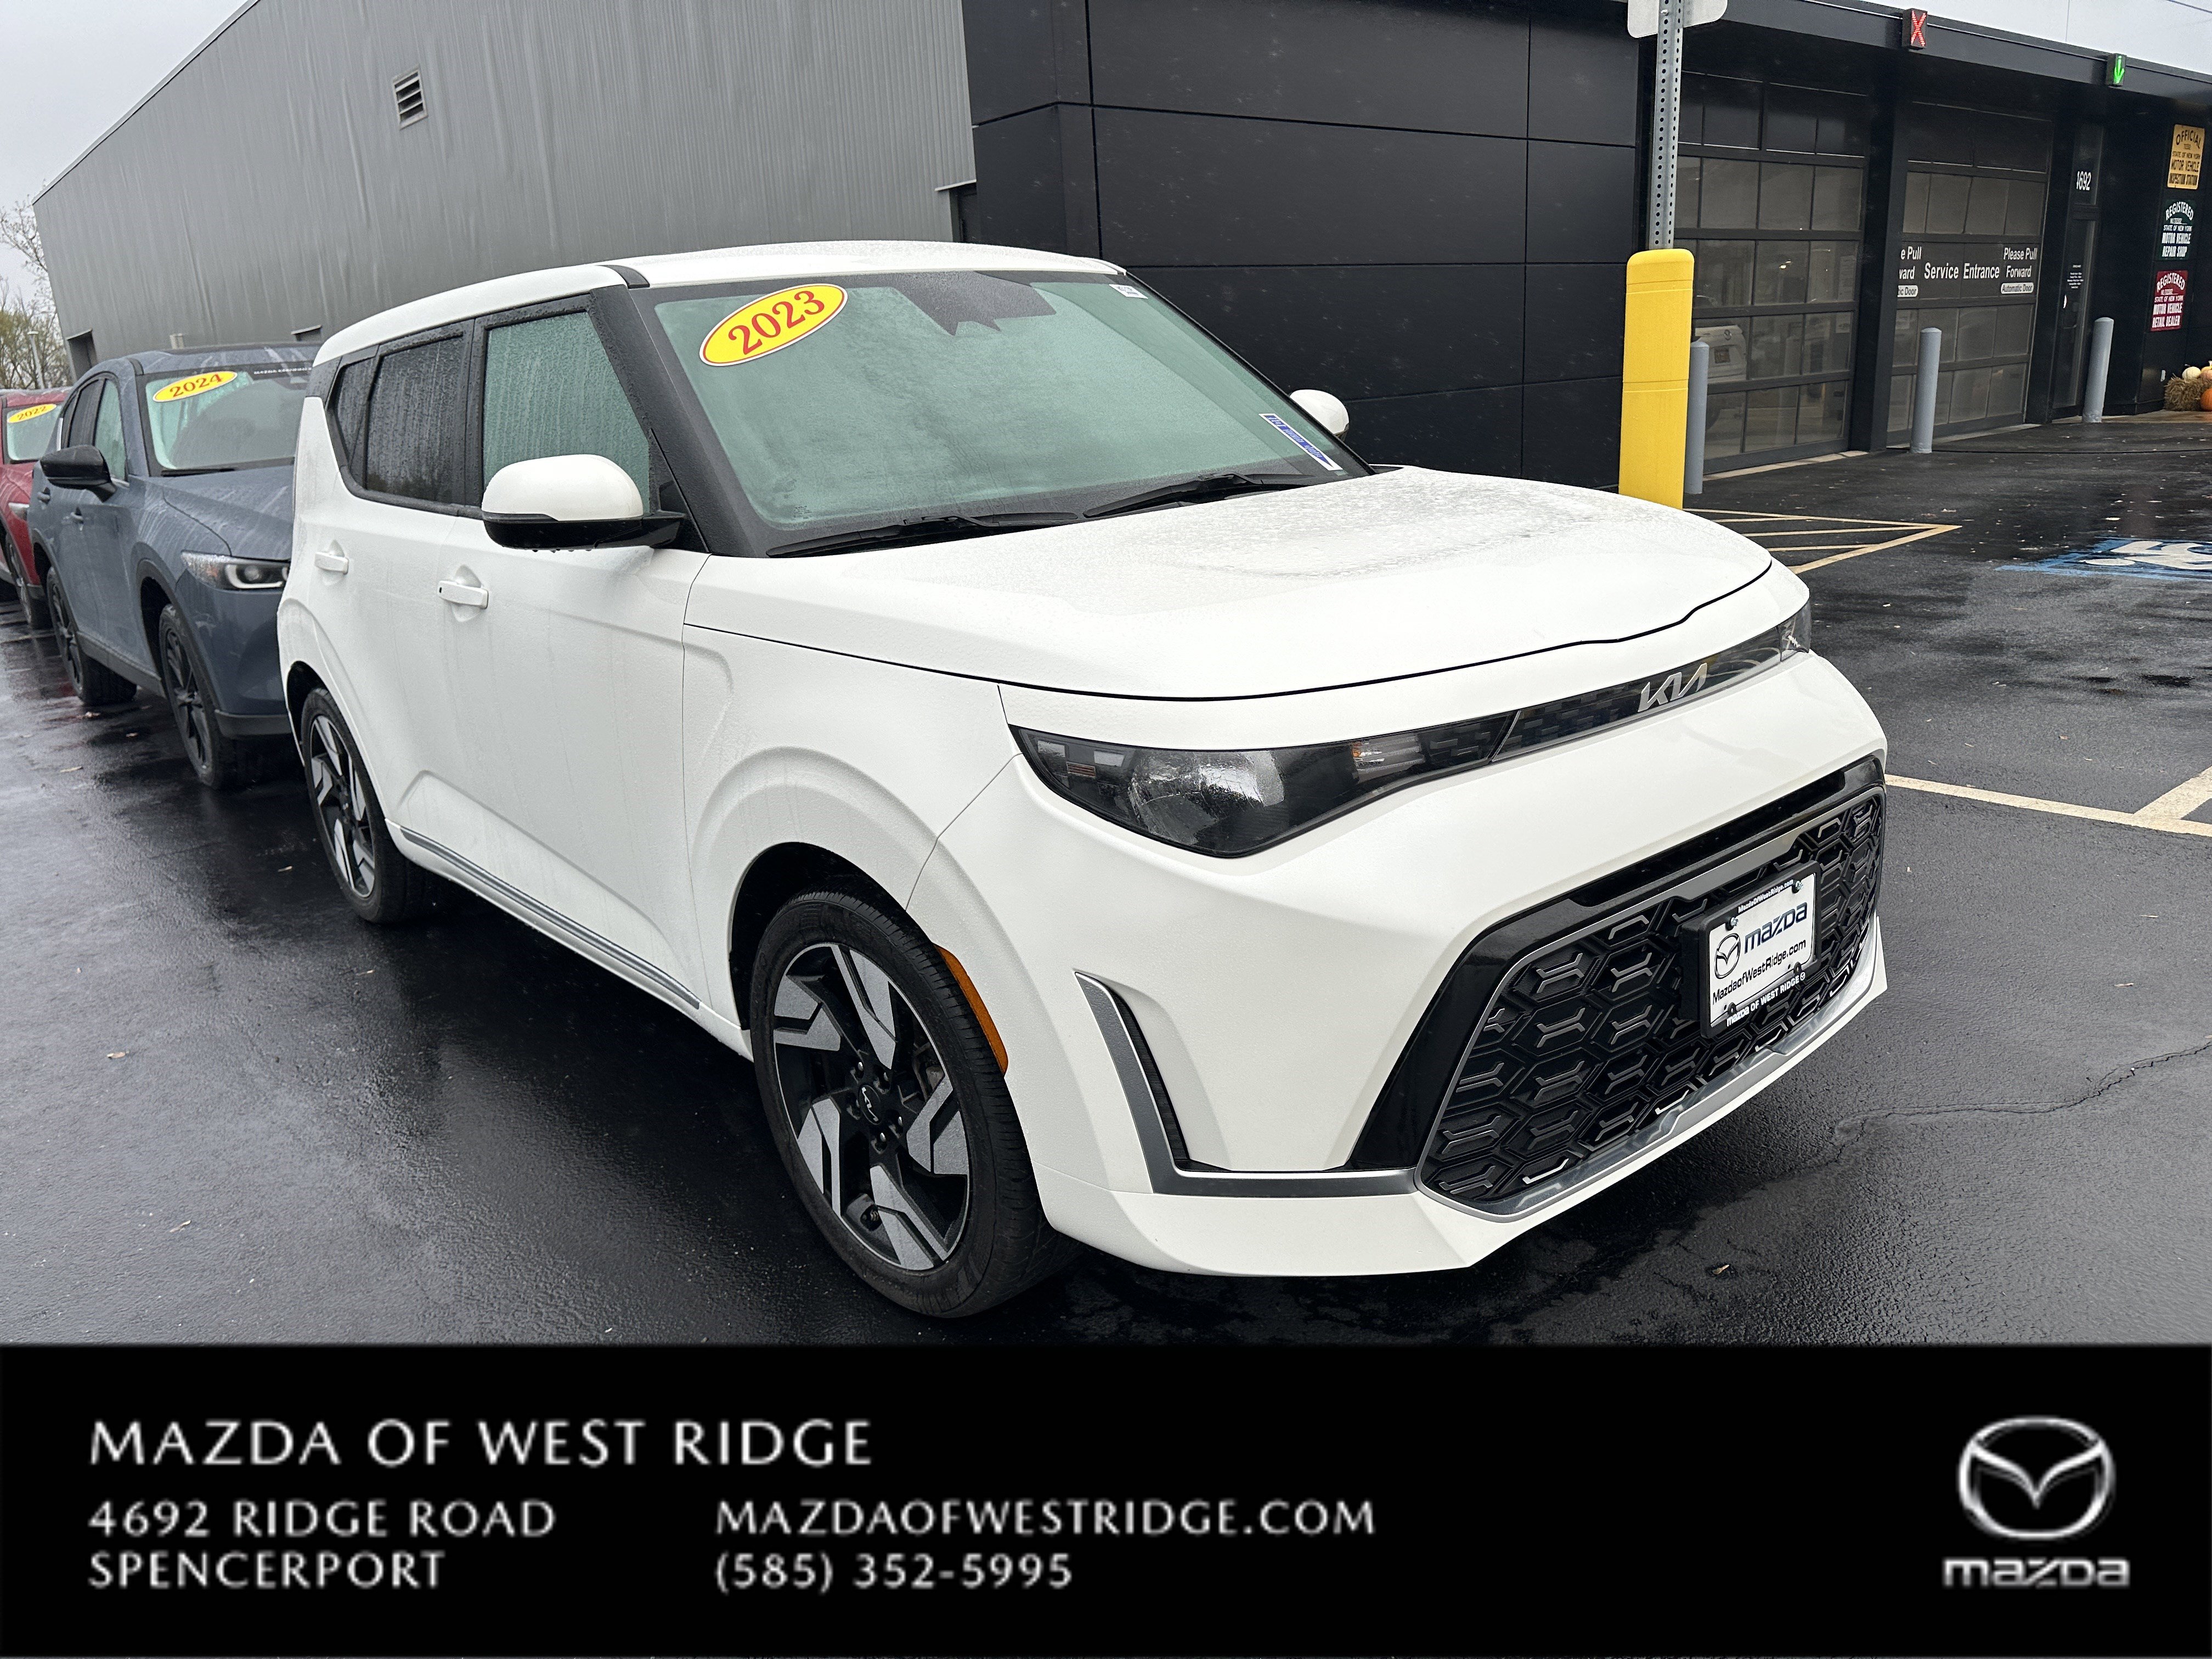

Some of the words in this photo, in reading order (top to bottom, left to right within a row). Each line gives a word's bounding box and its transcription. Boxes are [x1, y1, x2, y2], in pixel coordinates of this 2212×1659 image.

[2176, 129, 2201, 149] OFFICIAL
[2165, 201, 2194, 221] REGISTERED
[1907, 246, 1922, 260] Pull
[2004, 247, 2024, 260] Please
[2025, 247, 2038, 260] Pull
[1924, 262, 1959, 279] Service
[1963, 263, 2000, 279] Entrance
[2006, 265, 2032, 278] Forward
[1905, 286, 1917, 296] Door
[2157, 272, 2185, 293] REGISTERED
[728, 290, 825, 355] 2023
[170, 374, 222, 397] 2024
[1712, 939, 1806, 1005] MazdaofWestRidge.com
[1760, 988, 1779, 1006] WEST
[1780, 974, 1799, 994] RIDGE
